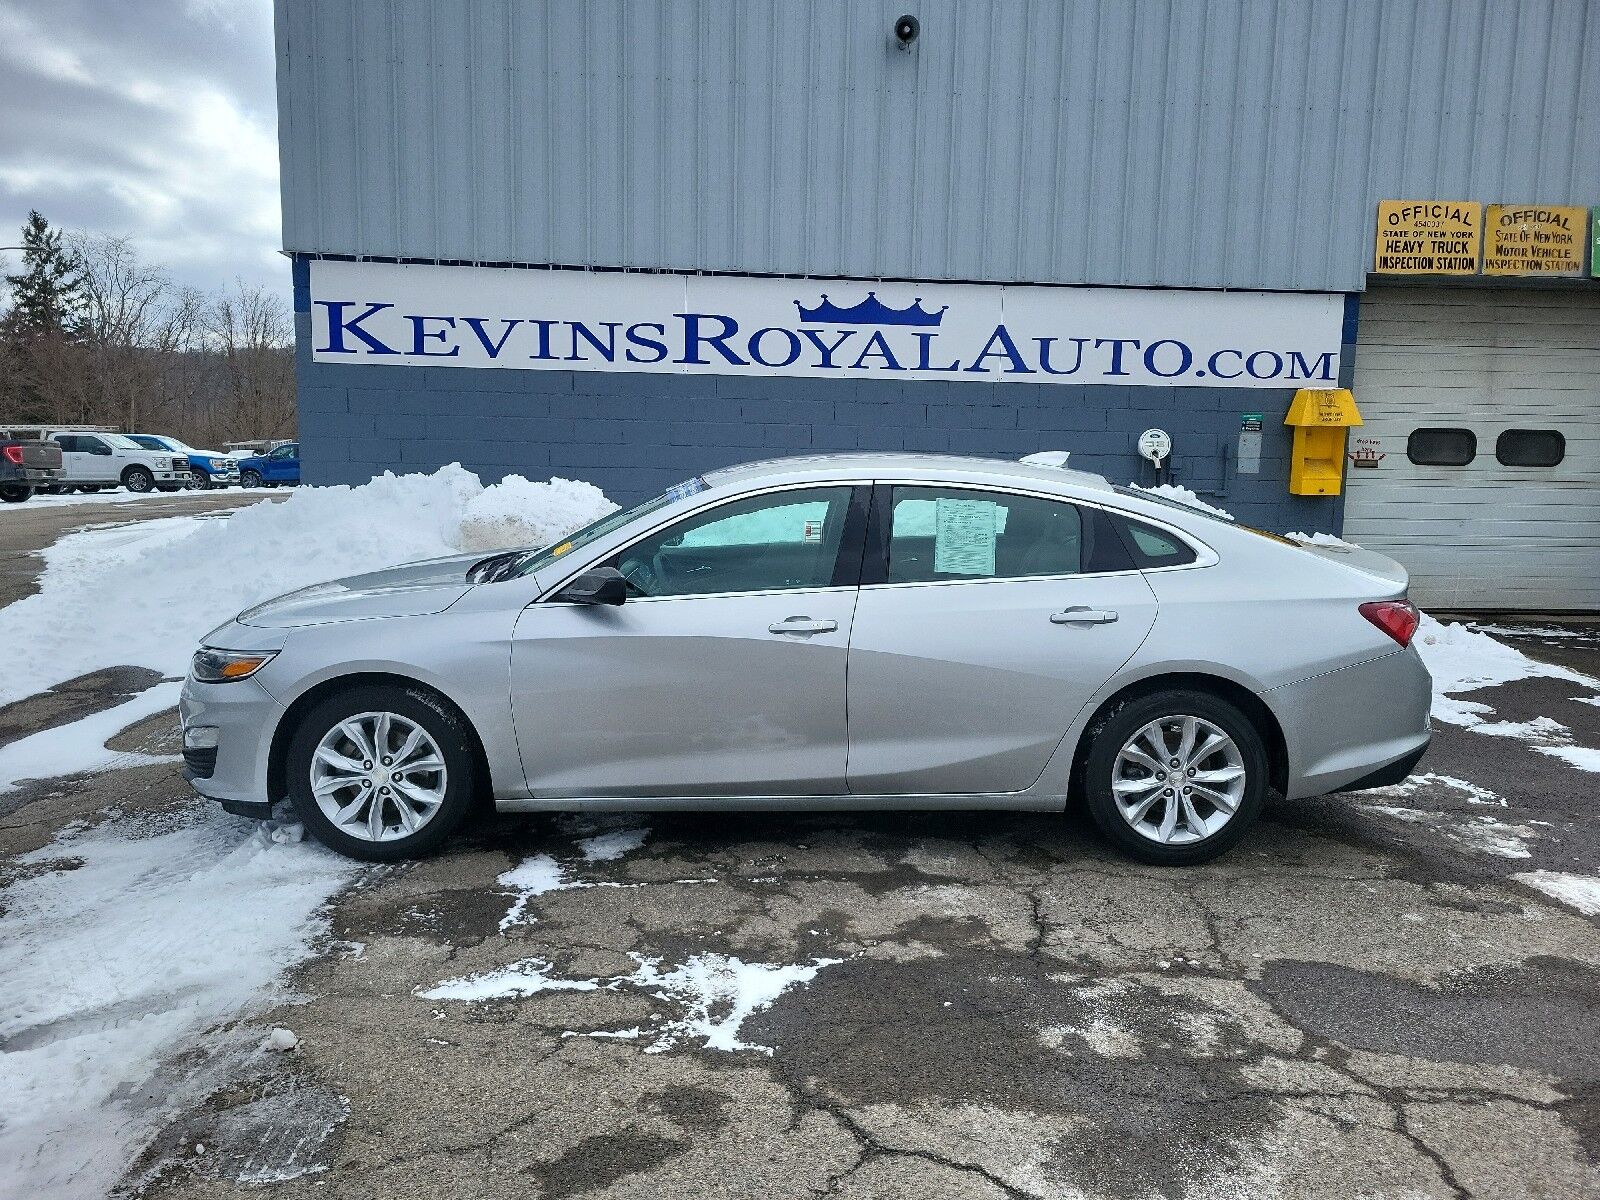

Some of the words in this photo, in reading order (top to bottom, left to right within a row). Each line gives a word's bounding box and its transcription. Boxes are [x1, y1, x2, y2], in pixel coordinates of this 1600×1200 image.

[1389, 205, 1472, 226] OFFICIAL
[1500, 210, 1571, 231] OFFICIAL
[1496, 230, 1517, 242] STATE
[1520, 230, 1531, 242] OF
[1534, 231, 1551, 243] NEW
[1552, 232, 1573, 244] YORK
[1386, 240, 1424, 253] HEAVY
[1431, 241, 1468, 254] TRUCK
[1496, 244, 1527, 257] MOTOR
[1531, 245, 1571, 258] VEHICLE
[1379, 256, 1433, 269] INSPECTION
[1436, 257, 1475, 270] STATION
[1485, 259, 1542, 270] INSPECTION
[1544, 260, 1580, 271] STATION
